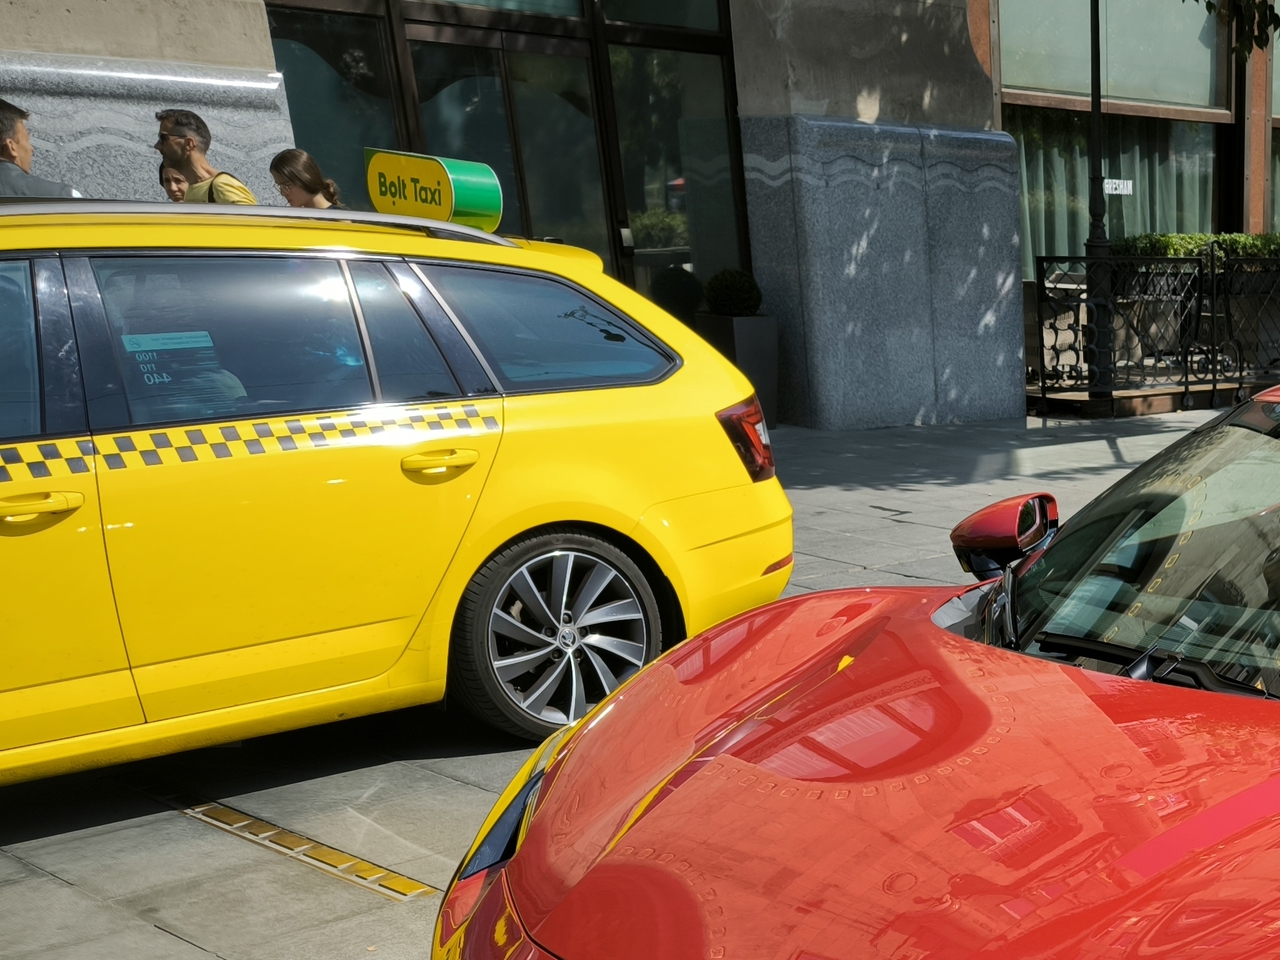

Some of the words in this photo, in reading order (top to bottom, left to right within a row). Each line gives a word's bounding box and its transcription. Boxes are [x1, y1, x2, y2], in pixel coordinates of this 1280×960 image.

[378, 172, 407, 205] Bolt
[410, 177, 442, 207] Taxi
[1104, 178, 1132, 195] GRESHAM
